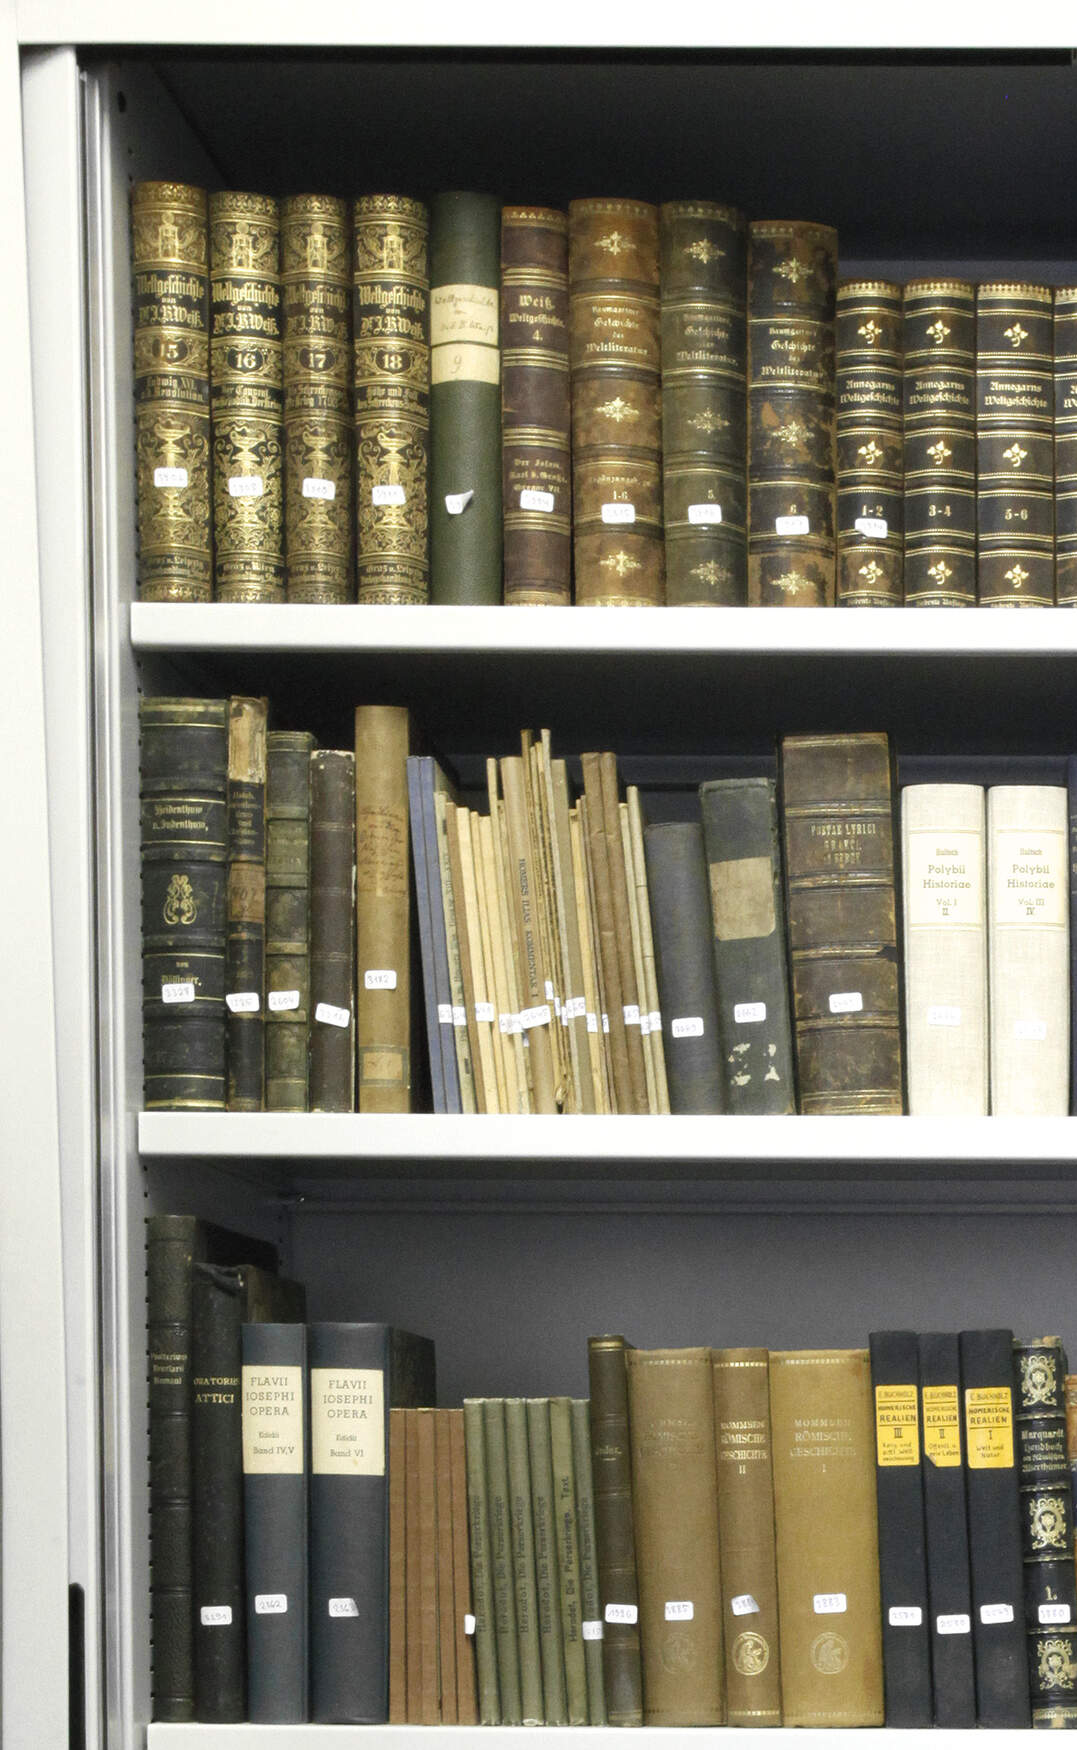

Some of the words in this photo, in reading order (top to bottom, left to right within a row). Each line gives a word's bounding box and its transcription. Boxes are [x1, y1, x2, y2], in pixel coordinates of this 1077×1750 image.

[235, 353, 257, 369] 16
[308, 353, 327, 369] 17
[382, 354, 403, 369] 18
[928, 863, 967, 878] Polybii
[1012, 863, 1051, 878] Polybii
[922, 879, 972, 891] Historiae
[1006, 879, 1056, 891] Historiae
[250, 1377, 288, 1387] FLAVII
[328, 1380, 368, 1390] FLAVII
[195, 1393, 236, 1404] ATTICI
[246, 1391, 296, 1402] IOSEPHI
[323, 1394, 374, 1405] IOSEPHI
[249, 1406, 290, 1416] OPERA
[327, 1409, 368, 1419] OPERA
[879, 1414, 917, 1423] REALIEN
[926, 1415, 958, 1423] REALIEN
[970, 1416, 1008, 1425] REALIEN
